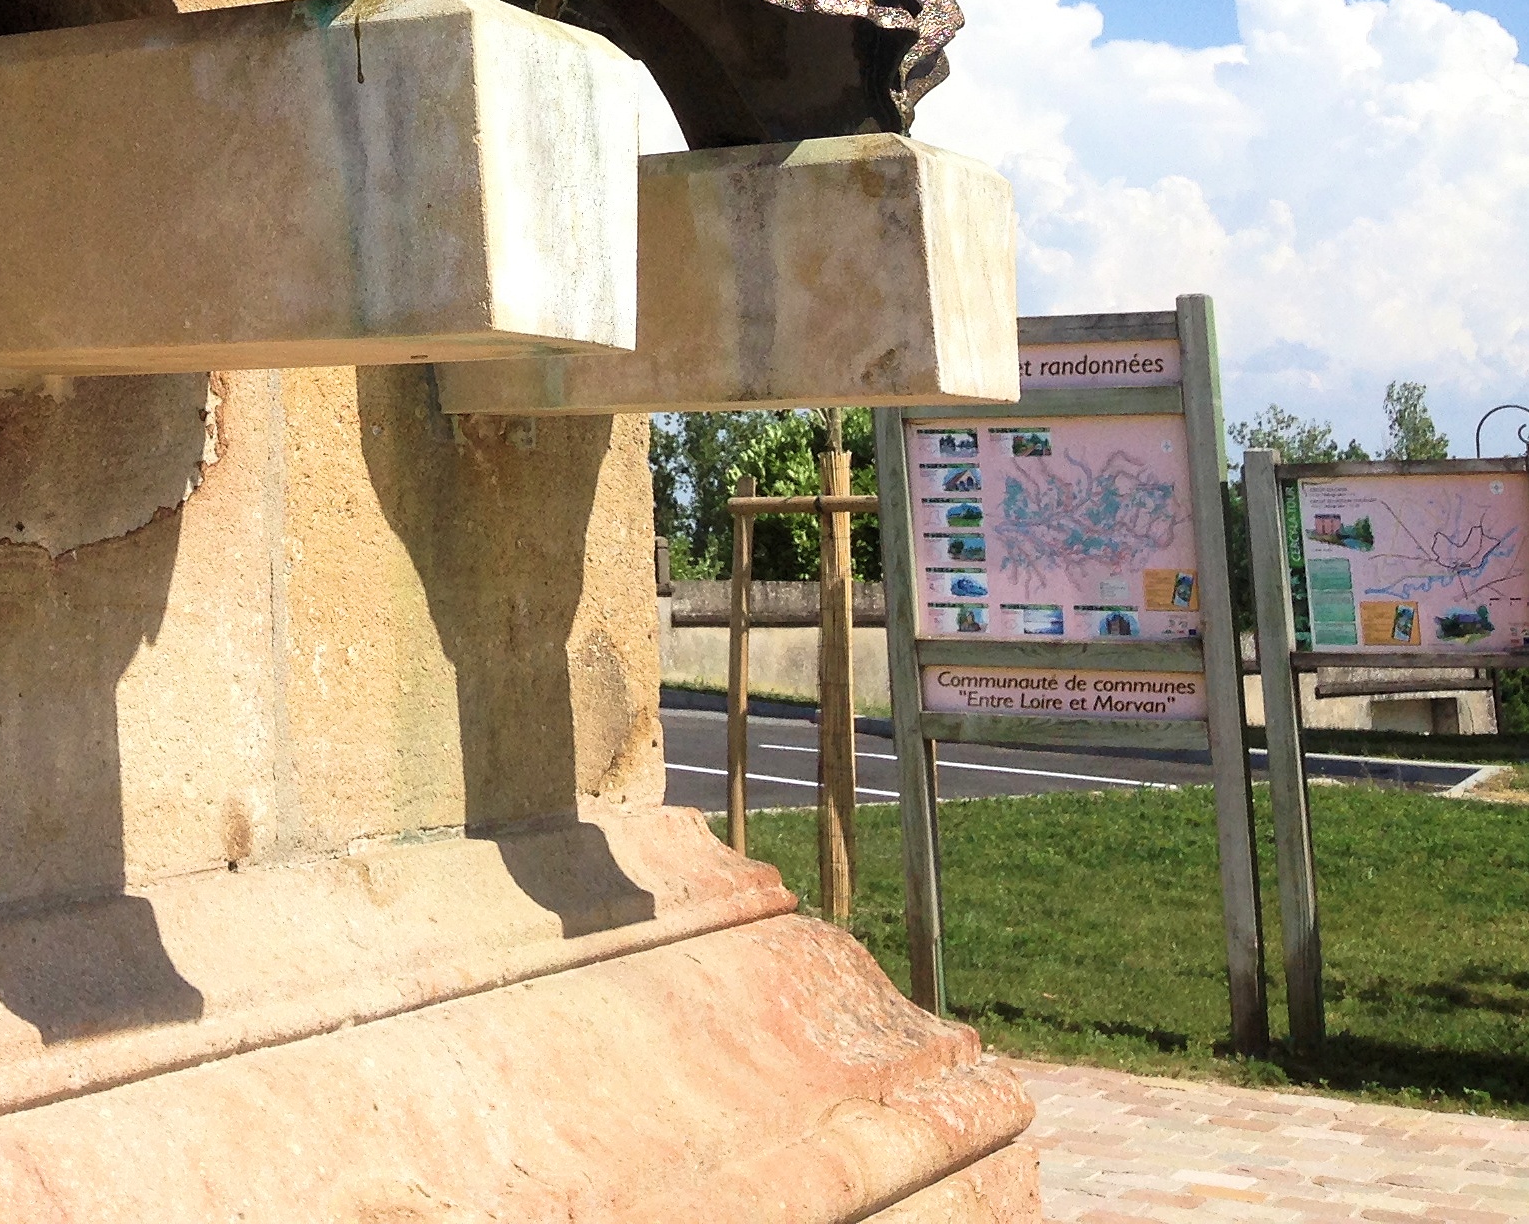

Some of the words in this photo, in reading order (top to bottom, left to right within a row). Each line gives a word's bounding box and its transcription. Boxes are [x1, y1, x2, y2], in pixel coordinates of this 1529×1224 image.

[1040, 353, 1164, 376] randonnées
[937, 671, 1059, 691] Communauté
[1065, 675, 1087, 692] de
[1093, 679, 1196, 695] communes
[958, 690, 1013, 709] "Entre
[1021, 693, 1062, 711] Loire
[1069, 696, 1087, 711] et
[1093, 694, 1176, 714] Morvan"
